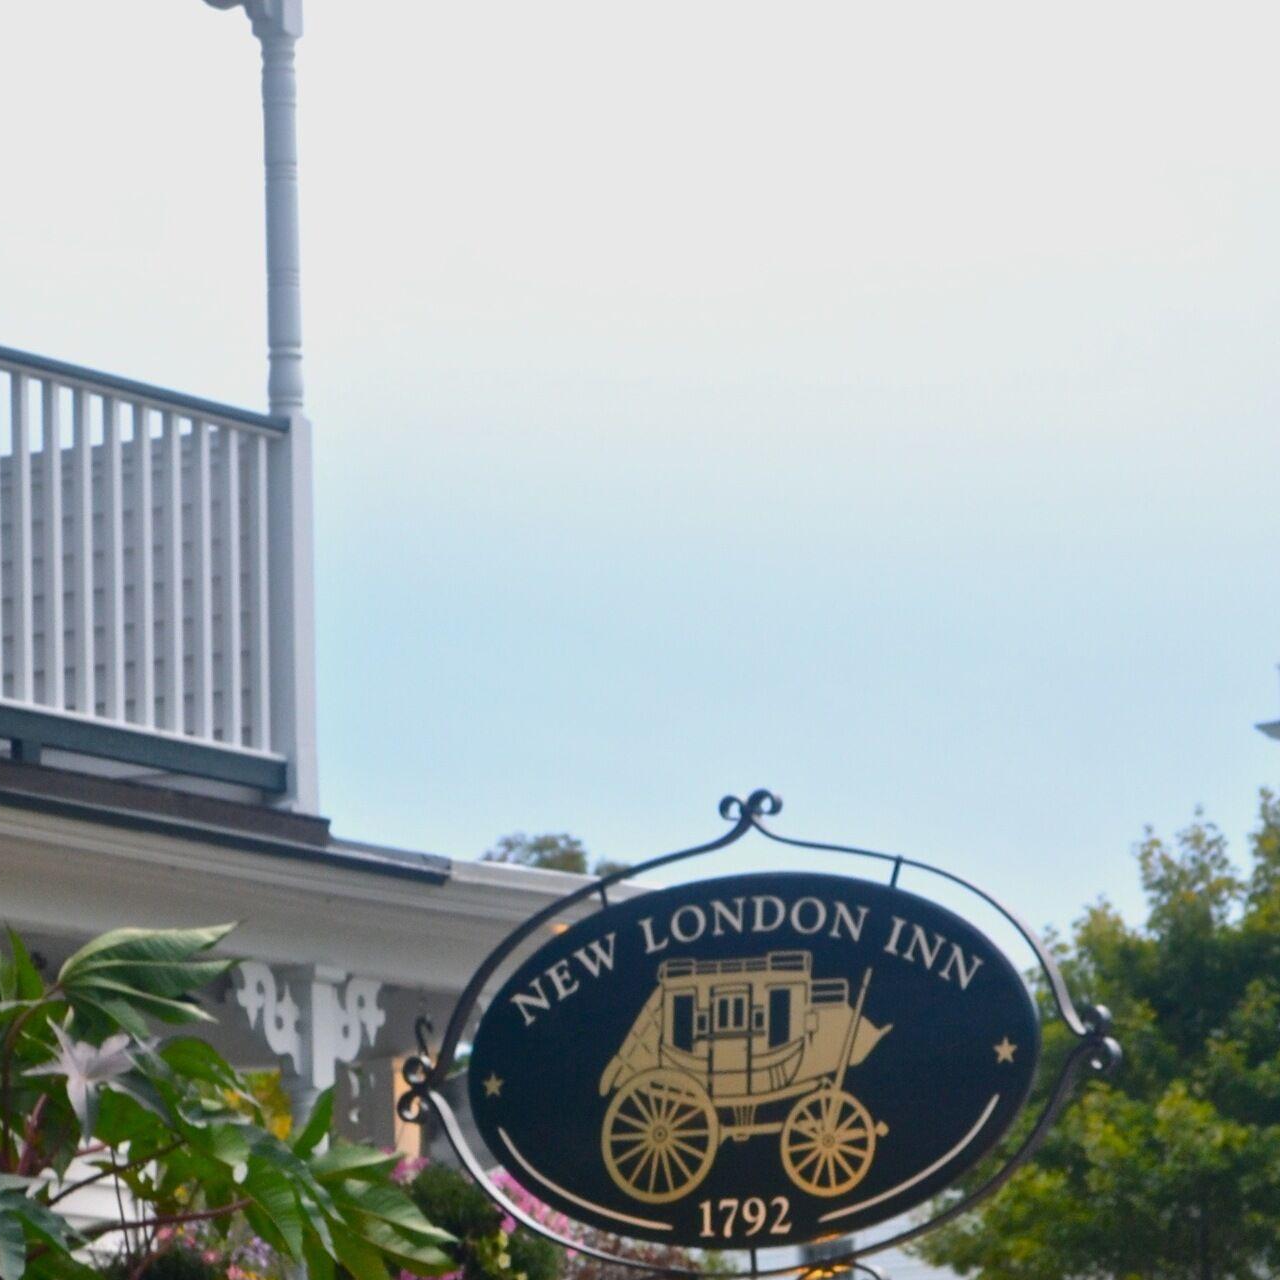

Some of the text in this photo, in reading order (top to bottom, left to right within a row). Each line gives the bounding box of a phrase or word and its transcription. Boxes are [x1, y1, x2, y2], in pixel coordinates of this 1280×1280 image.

[510, 895, 984, 1026] NEW LONDON INN
[699, 1195, 793, 1239] 1792
